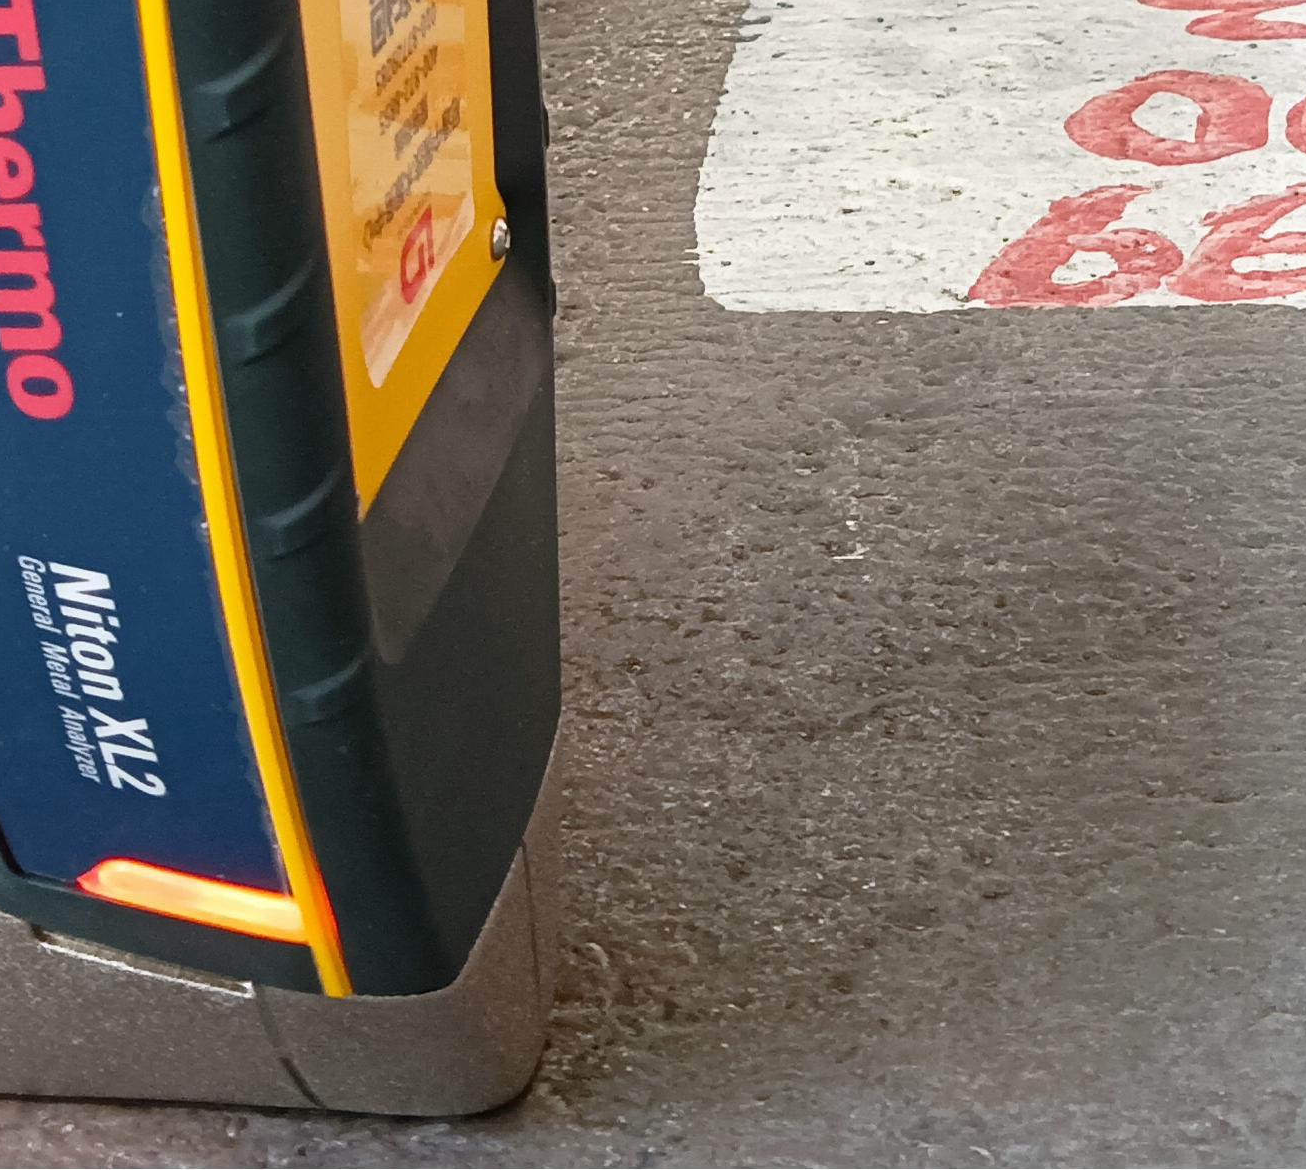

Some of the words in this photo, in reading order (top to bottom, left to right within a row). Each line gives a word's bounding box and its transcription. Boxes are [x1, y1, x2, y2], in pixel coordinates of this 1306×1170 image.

[17, 555, 63, 635] General
[47, 561, 125, 701] Niton
[39, 640, 82, 701] Metal
[57, 704, 101, 785] Analyzer
[85, 705, 168, 797] XL2
